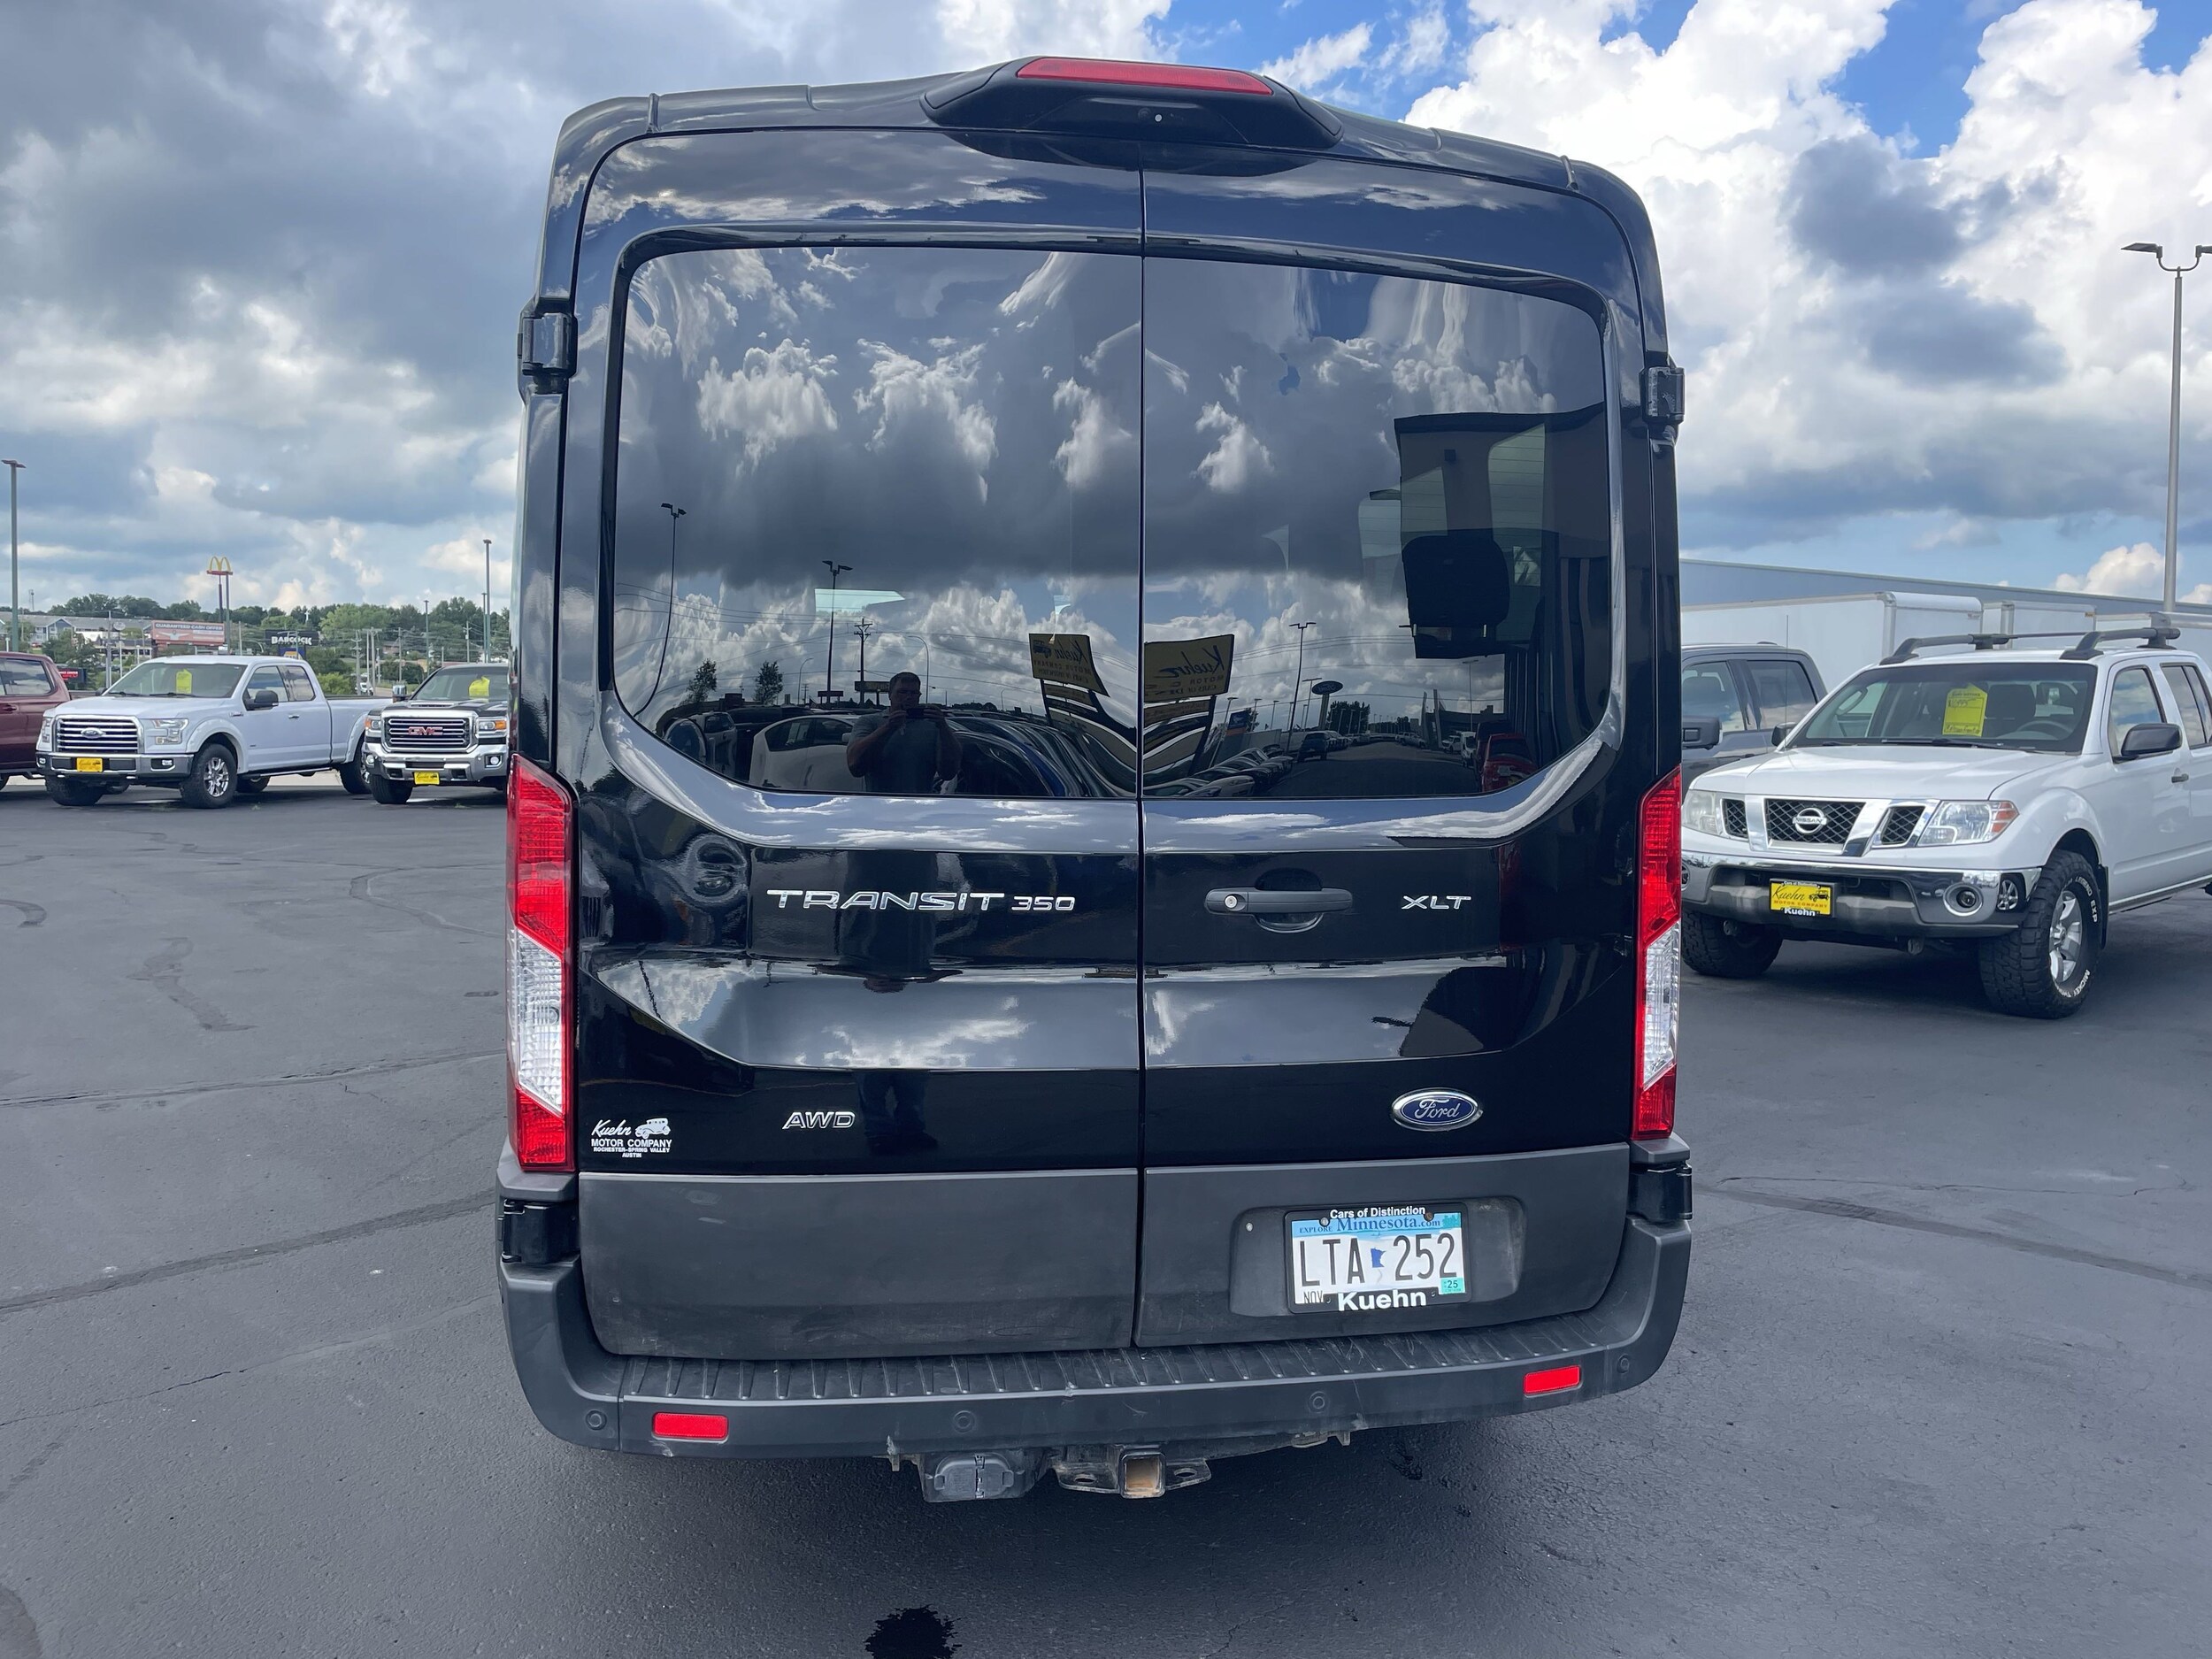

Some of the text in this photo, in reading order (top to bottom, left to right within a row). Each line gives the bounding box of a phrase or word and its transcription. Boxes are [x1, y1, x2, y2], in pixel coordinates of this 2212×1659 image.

[271, 635, 312, 646] BABCOCK
[408, 726, 443, 735] GMC
[766, 889, 1076, 911] TRANSIT 350
[1772, 885, 1805, 901] Kuehn
[1401, 895, 1471, 910] XLT
[1784, 908, 1816, 917] Kuehn
[1414, 1098, 1461, 1119] Ford
[781, 1111, 856, 1129] AWD
[591, 1119, 632, 1138] Kuehn
[591, 1138, 672, 1148] MOTOR COMPANY
[1330, 1206, 1425, 1219] Cars of Distinction
[1336, 1217, 1440, 1232] Minnesota.com
[1299, 1233, 1458, 1287] LTA 252
[1447, 1279, 1458, 1288] 25
[1303, 1290, 1324, 1304] NOV
[1337, 1288, 1427, 1312] Kuehn
